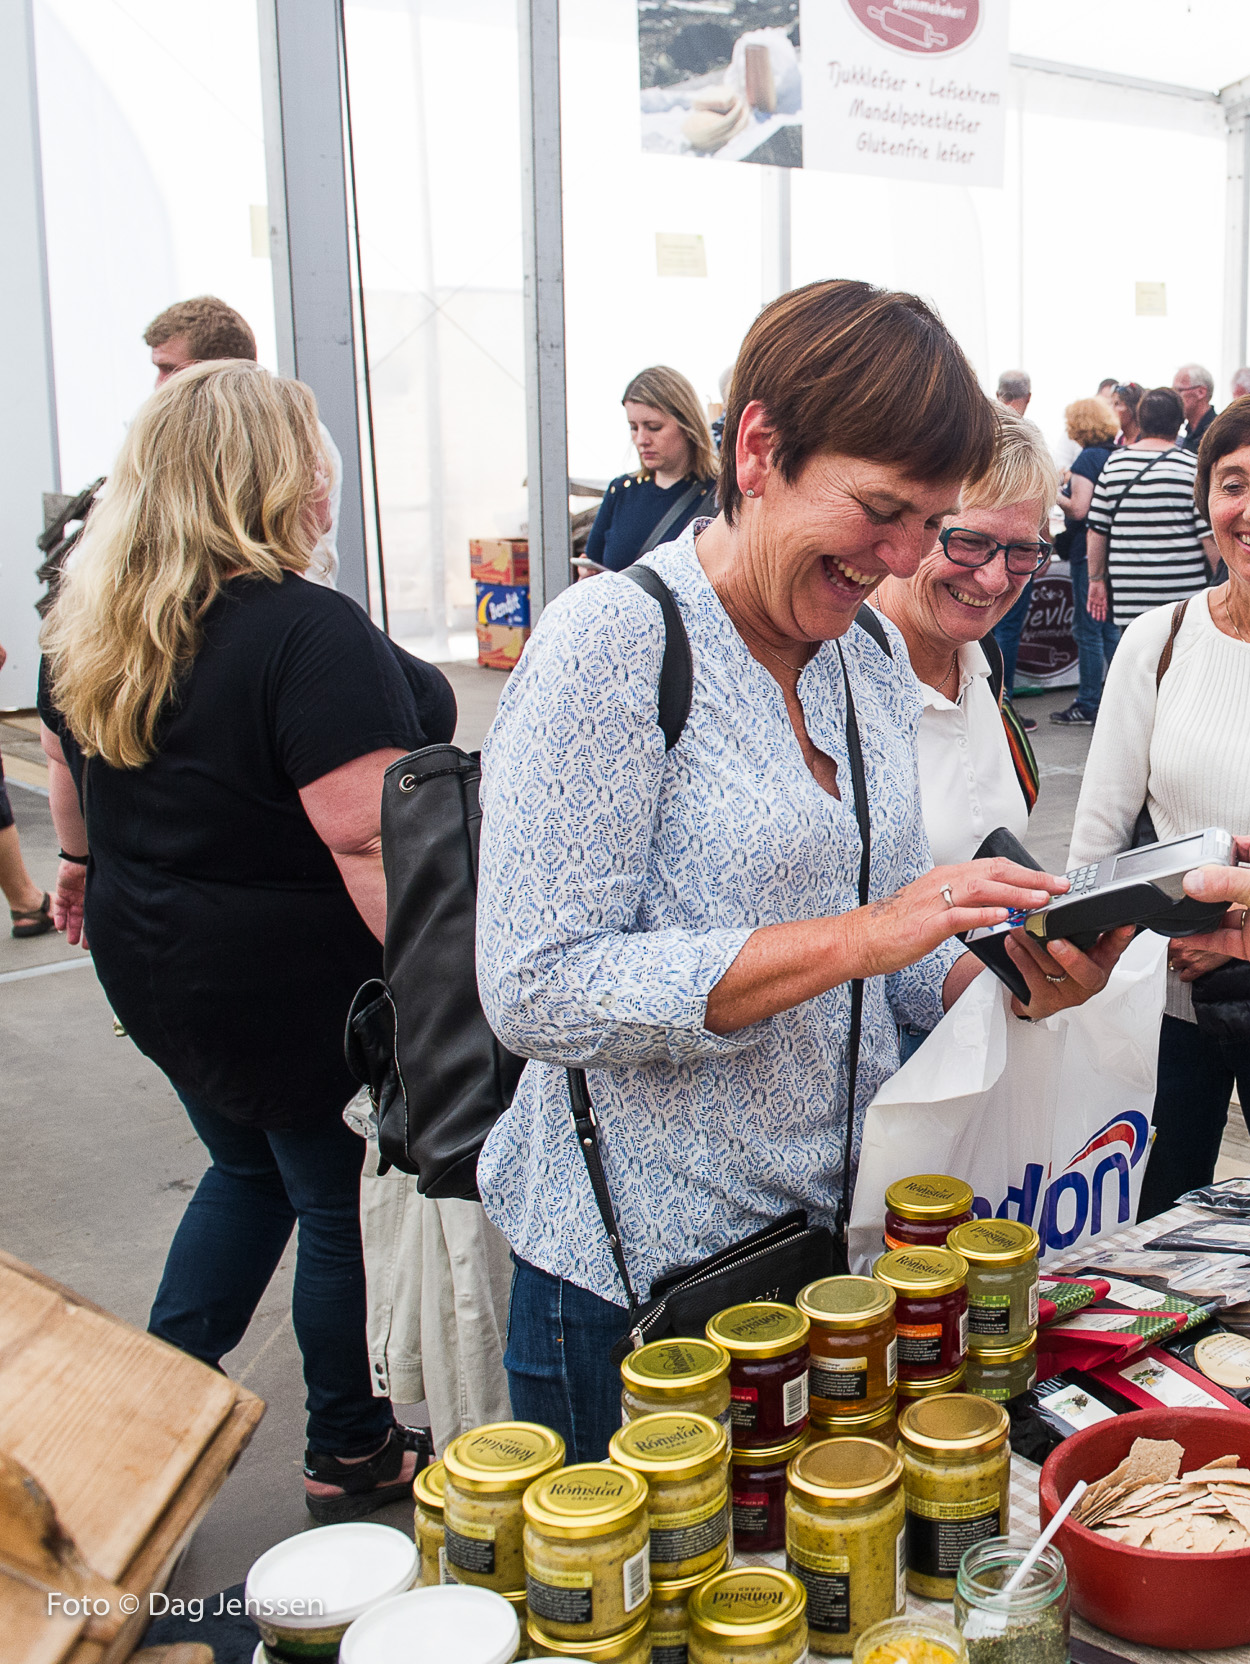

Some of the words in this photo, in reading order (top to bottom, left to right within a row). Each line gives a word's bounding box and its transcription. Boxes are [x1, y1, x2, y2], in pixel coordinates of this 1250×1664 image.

[827, 61, 906, 91] Tjukklefser
[929, 78, 1001, 105] Lefsekrem
[849, 98, 981, 133] Mandelpotetlefser
[856, 132, 929, 159] Glutenfrie
[936, 142, 975, 163] lefser
